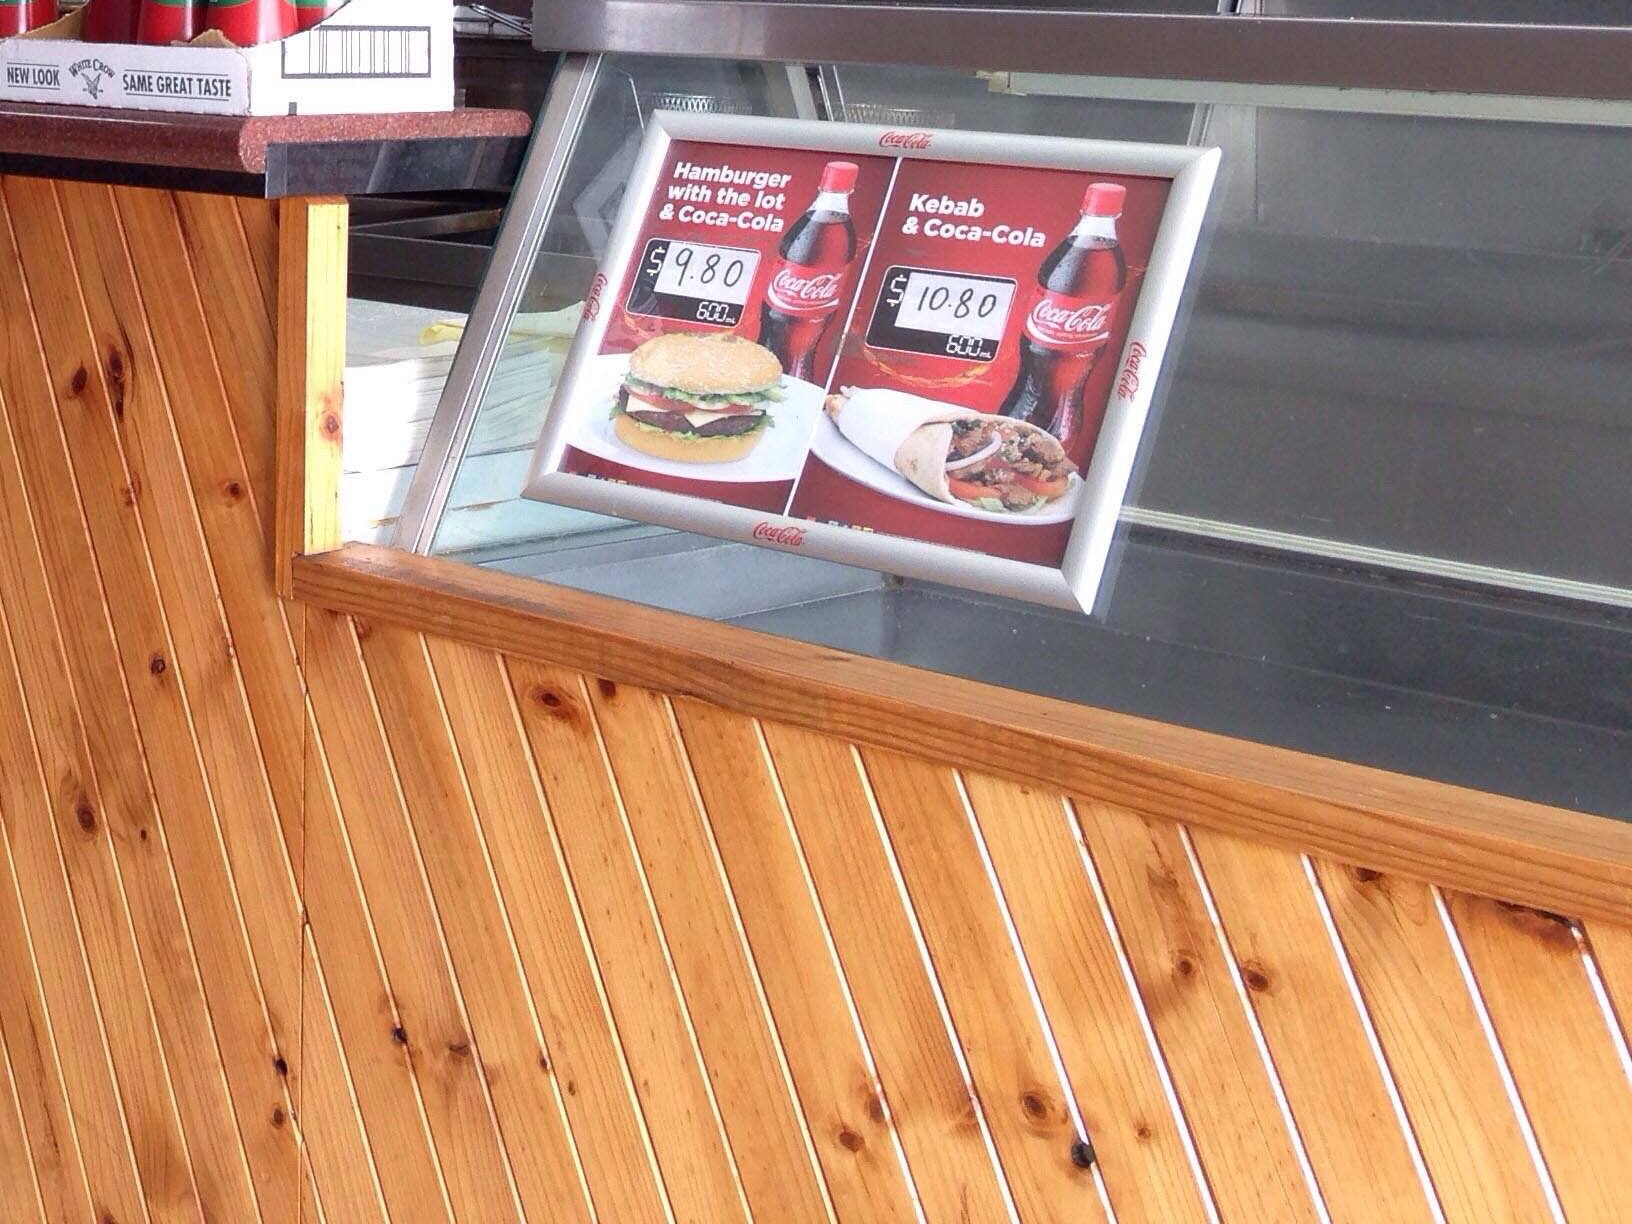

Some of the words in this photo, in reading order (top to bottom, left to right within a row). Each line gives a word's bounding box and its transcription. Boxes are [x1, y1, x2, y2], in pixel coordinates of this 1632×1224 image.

[7, 66, 30, 86] NEW
[33, 67, 60, 87] LOOK
[68, 59, 92, 77] WHITE
[92, 58, 116, 79] CROW
[122, 73, 153, 92] SAME
[156, 76, 192, 95] GREAT
[197, 78, 231, 97] TASTE
[673, 161, 792, 190] Hamburger
[668, 184, 712, 203] with
[718, 187, 751, 209] the
[754, 192, 786, 210] lot
[909, 193, 985, 218] Kebab
[659, 203, 674, 221] &
[678, 206, 785, 233] Coca-Cola
[901, 218, 919, 235] &
[924, 219, 1046, 248] Coca-Cola
[675, 247, 744, 288] 9.80
[917, 286, 997, 319] 10.80
